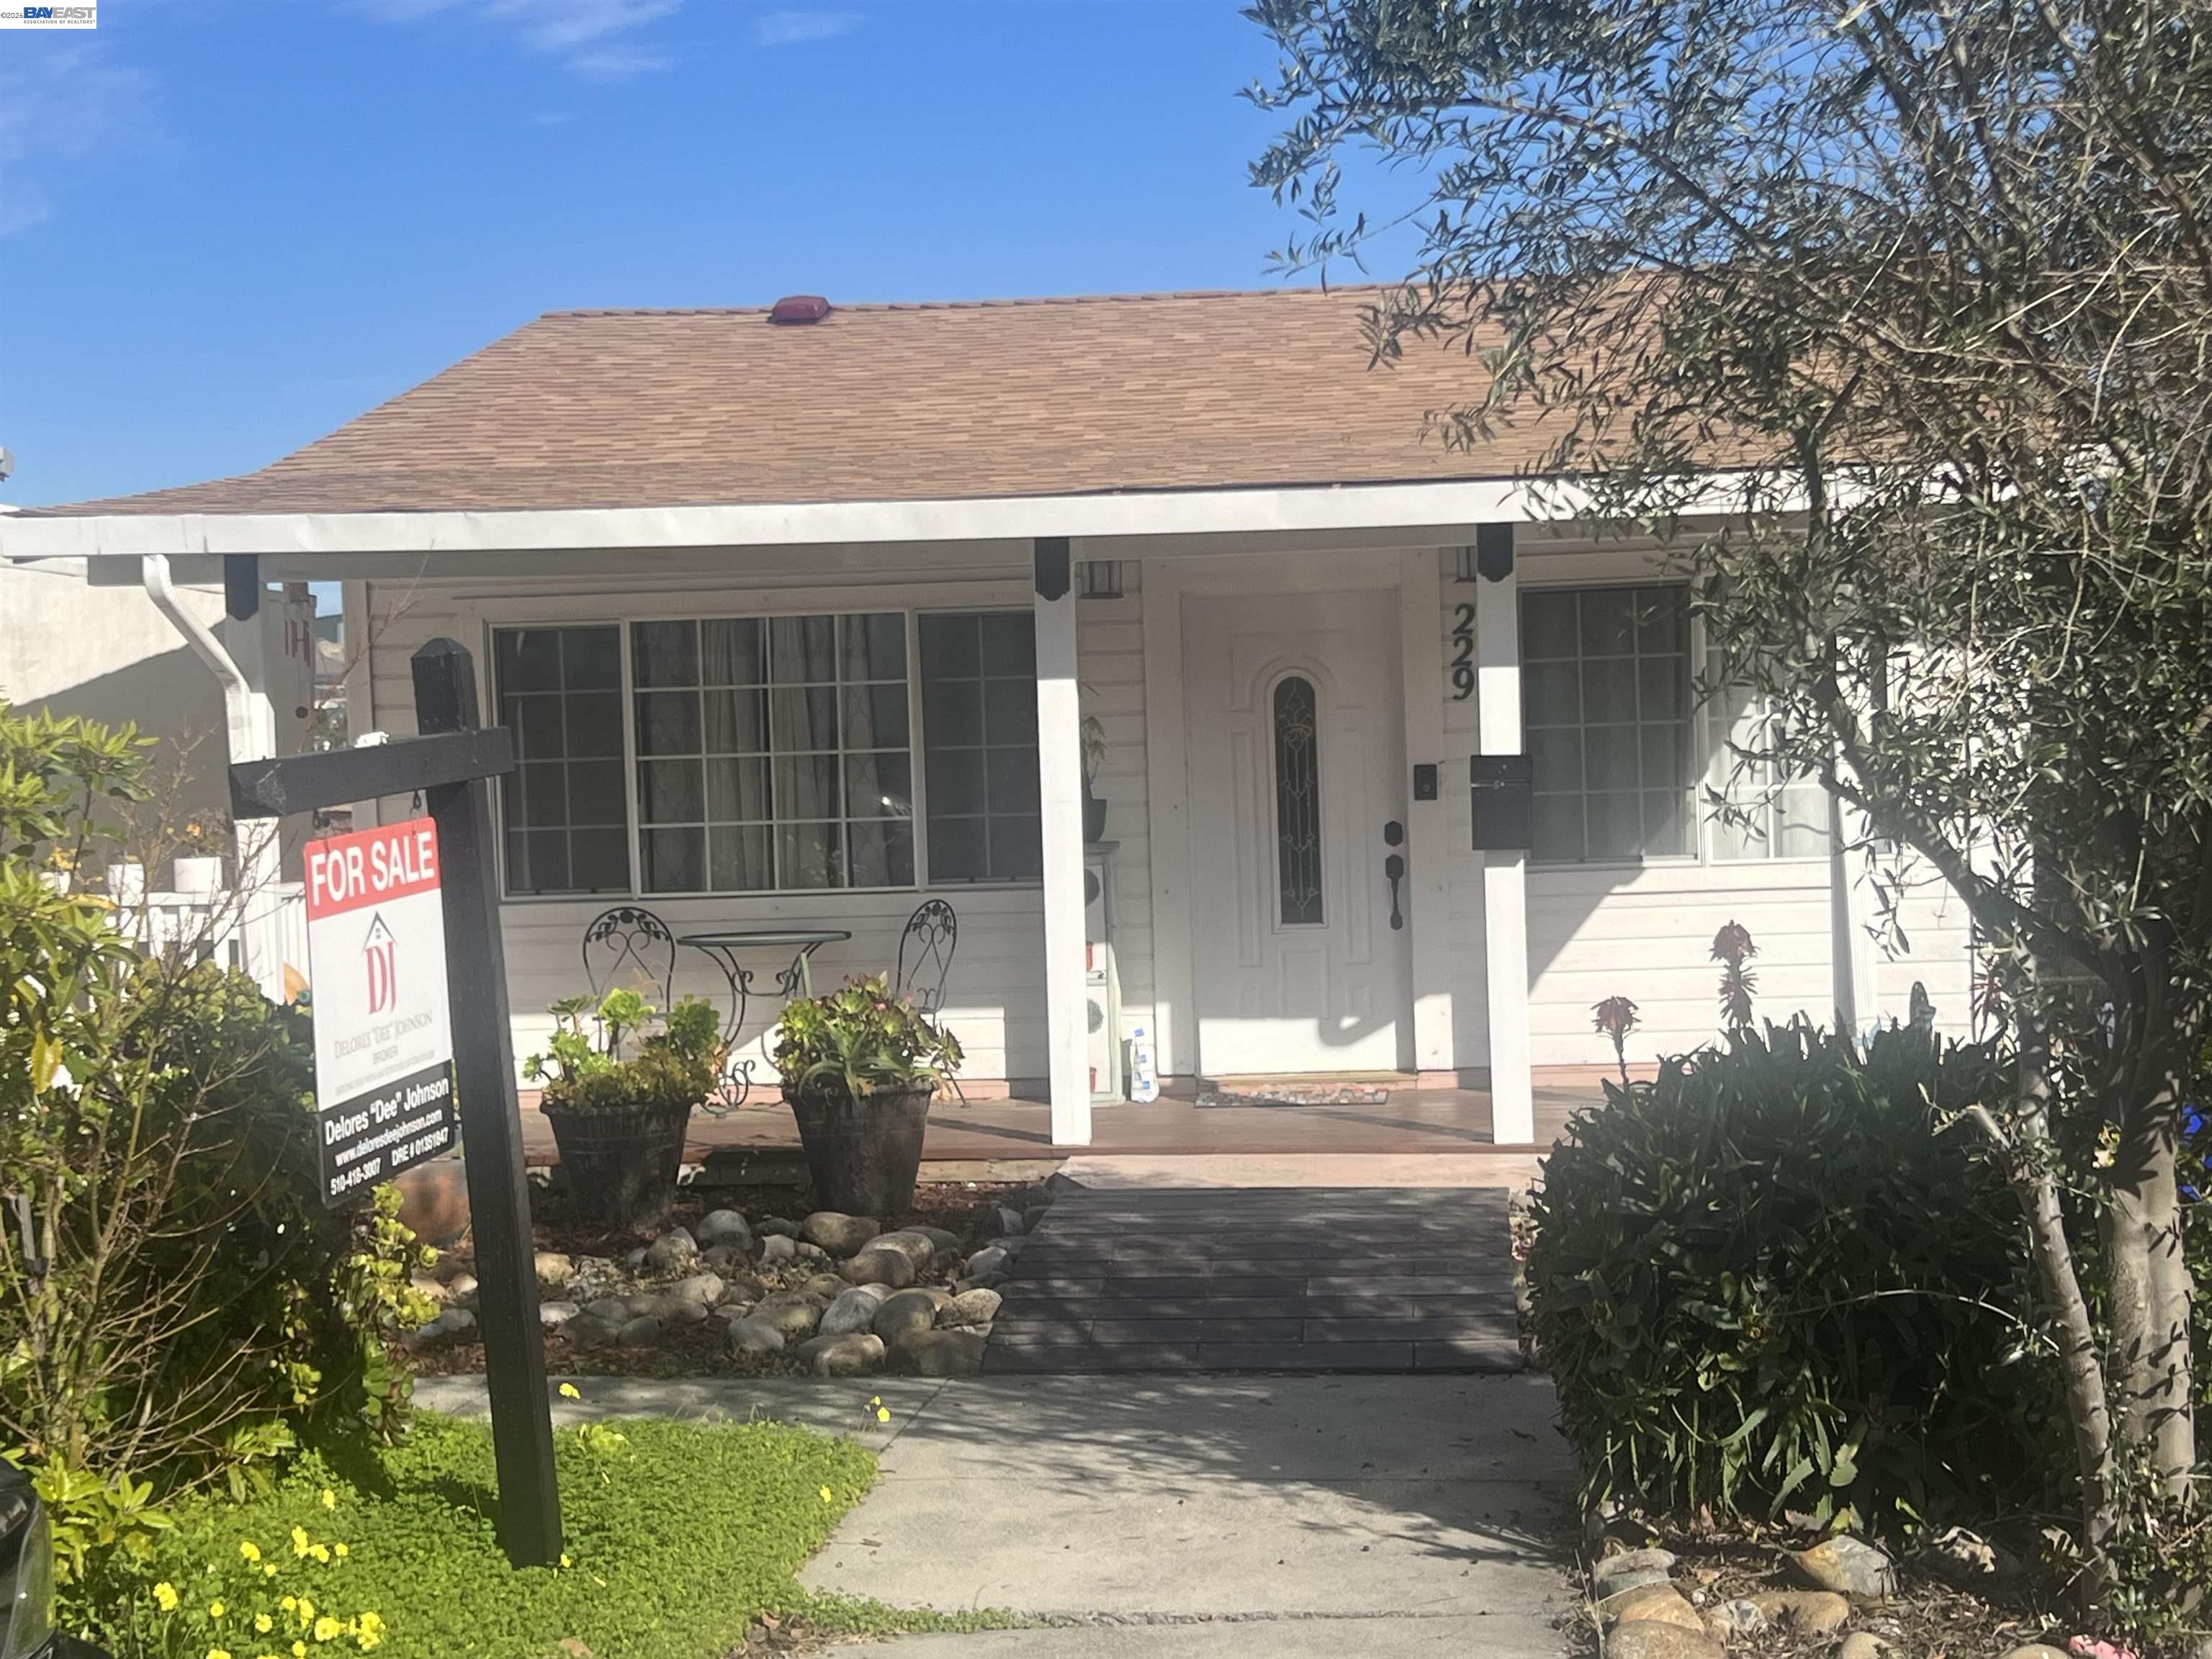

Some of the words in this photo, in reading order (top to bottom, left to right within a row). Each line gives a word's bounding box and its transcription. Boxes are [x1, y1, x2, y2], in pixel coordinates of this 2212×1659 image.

[310, 846, 366, 907] FOR
[371, 831, 435, 891] SALE
[366, 941, 396, 1015] DJ
[334, 1033, 371, 1059] DELORES
[395, 1010, 433, 1040] JOHNSON
[325, 1111, 369, 1146] Delores
[403, 1078, 449, 1111] Johnson
[335, 1109, 443, 1167] www.deloresdeejohnson.com
[392, 1144, 409, 1166] DRE
